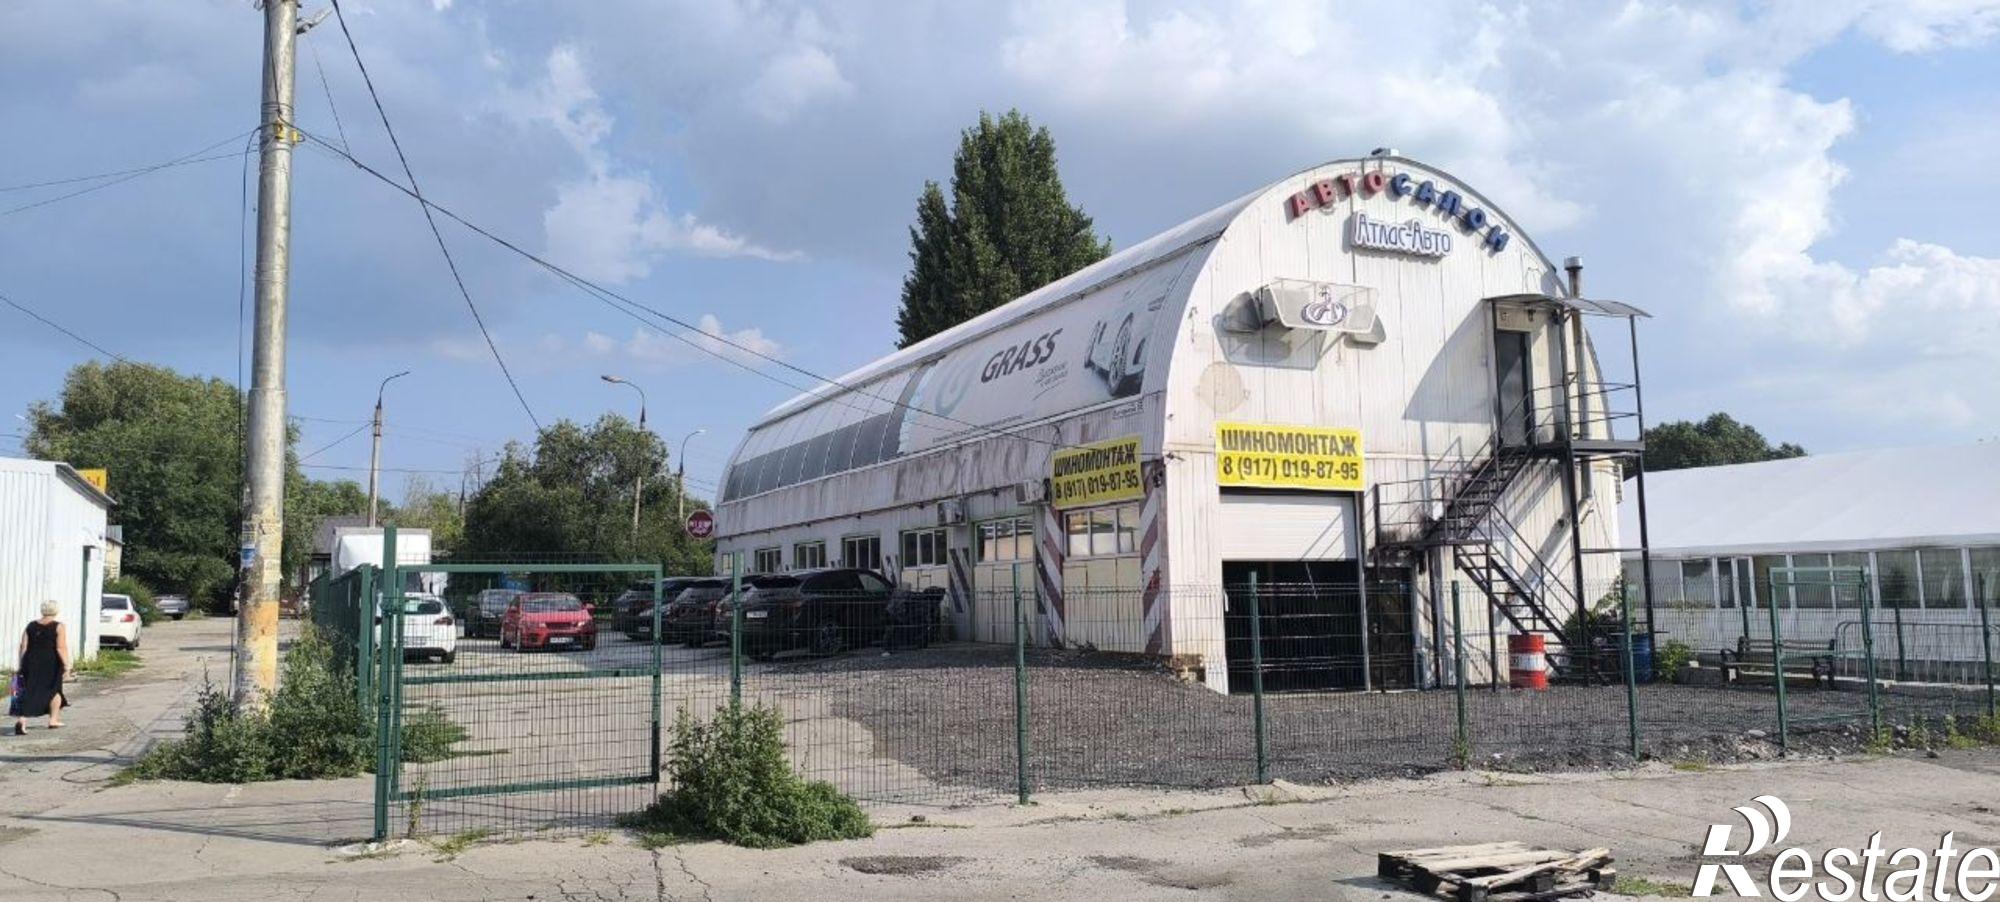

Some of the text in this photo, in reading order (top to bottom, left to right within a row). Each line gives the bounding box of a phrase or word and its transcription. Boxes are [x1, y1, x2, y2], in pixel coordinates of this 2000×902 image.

[1291, 170, 1510, 252] АВТОСАЛОН
[981, 328, 1064, 383] GRASS
[1054, 442, 1137, 477] ШИНОМОНТАЖ
[1221, 429, 1357, 457] ШИНОМОНТАЖ
[1055, 469, 1139, 500] 8 (917) 019-87-95
[1223, 456, 1359, 480] 8 (917) 019-87-95
